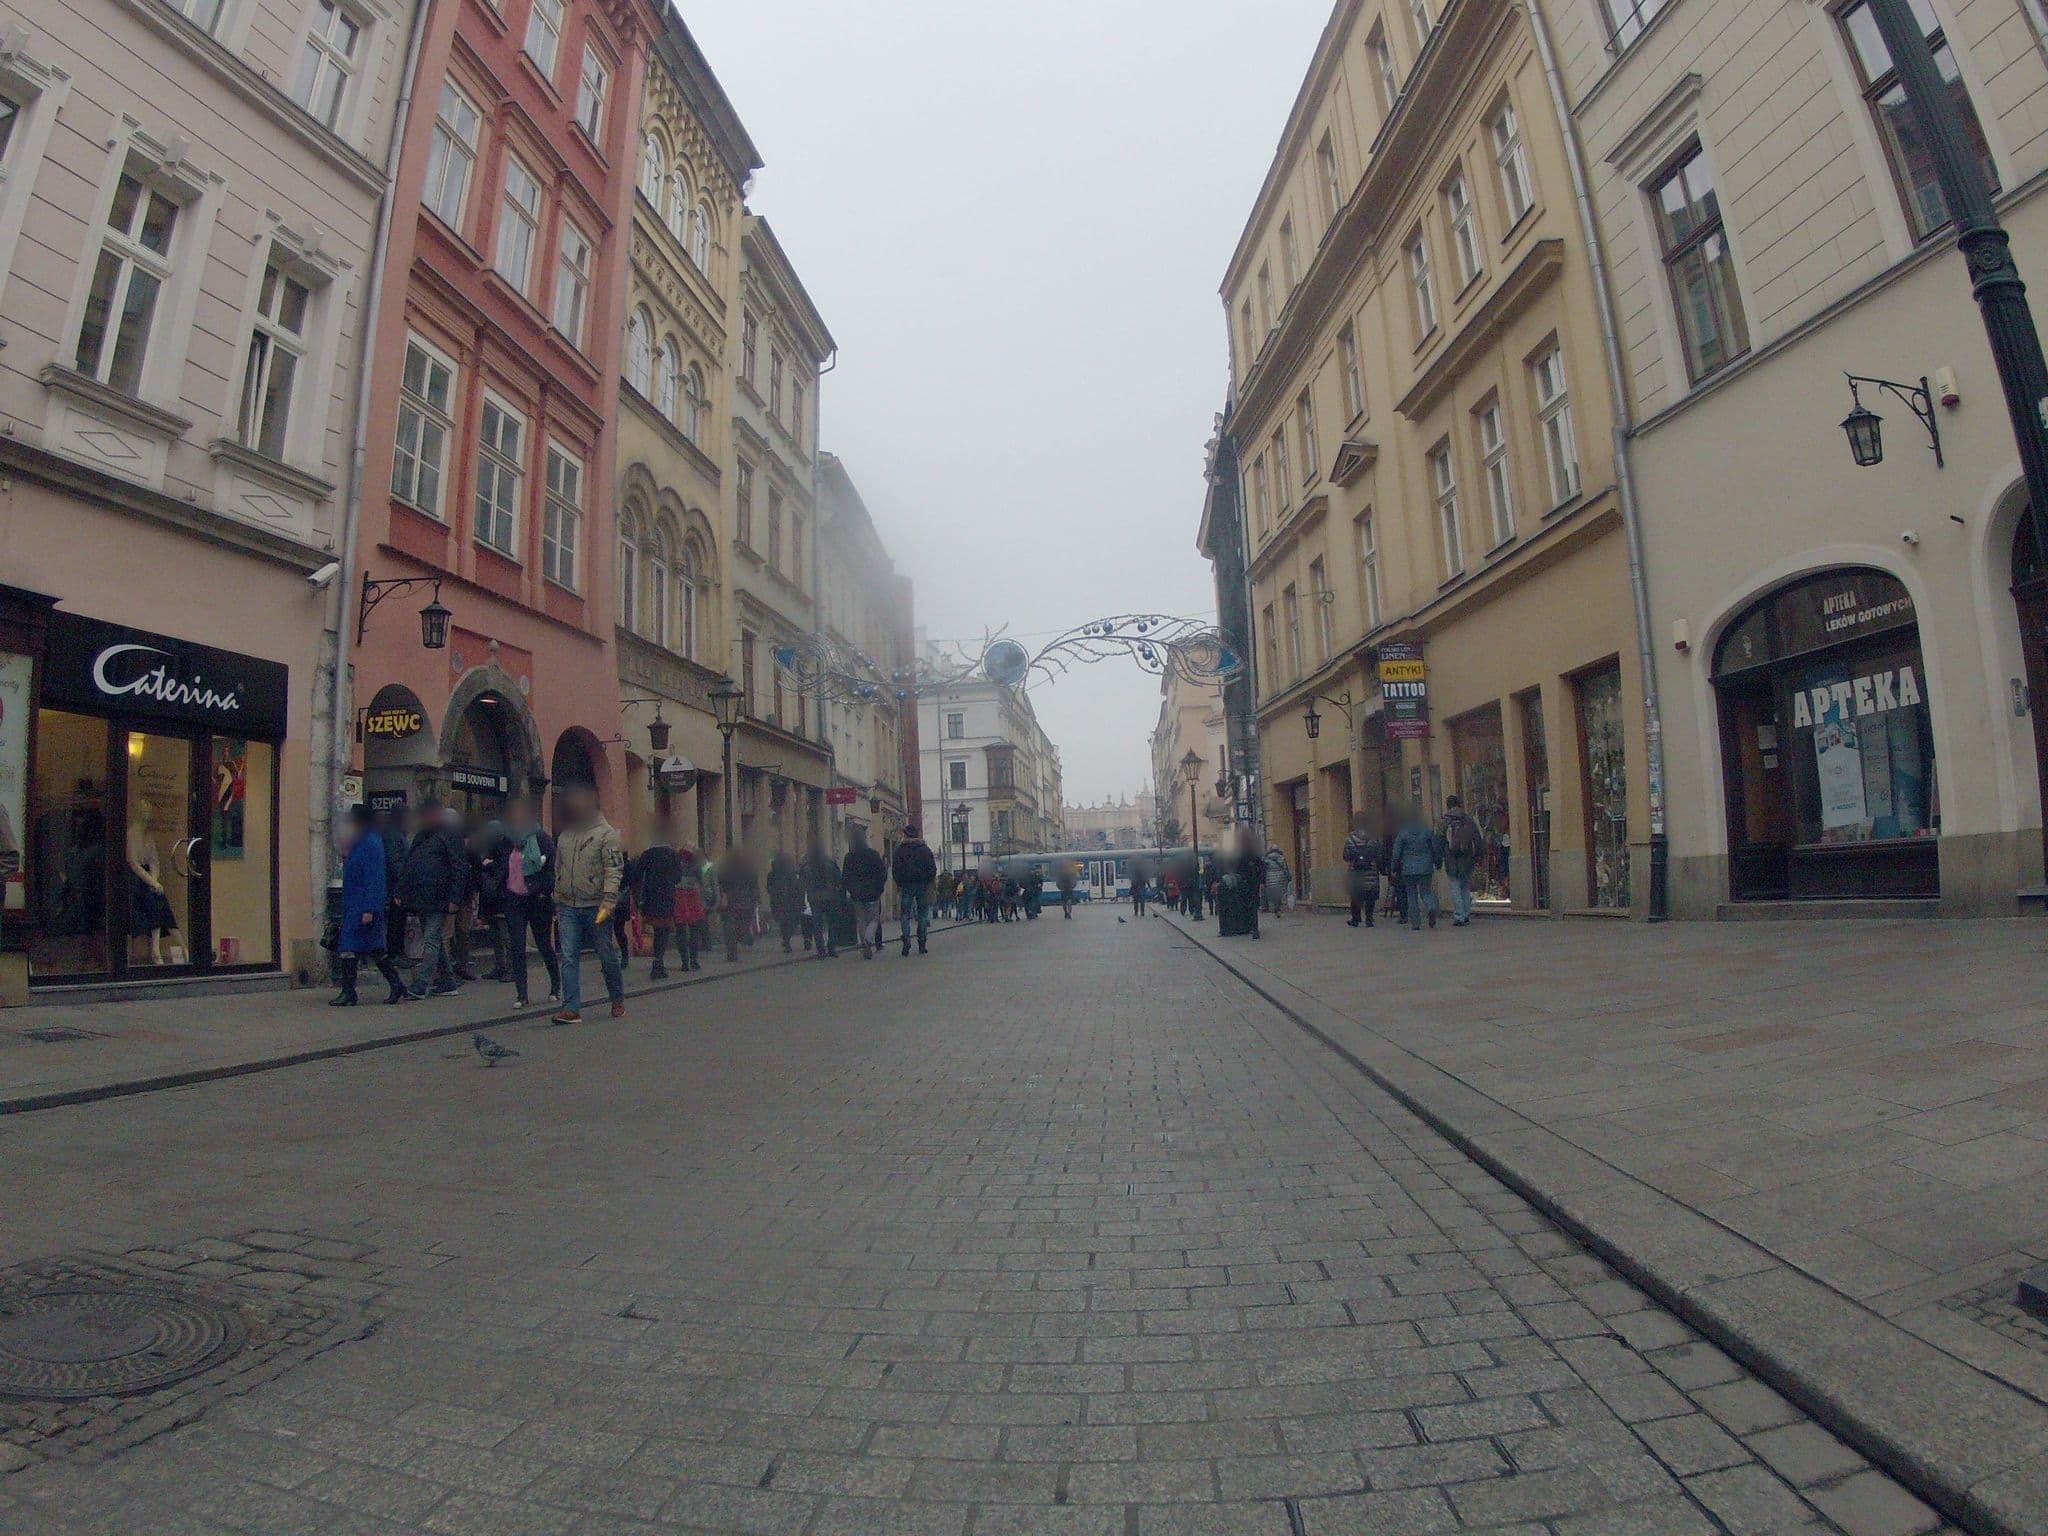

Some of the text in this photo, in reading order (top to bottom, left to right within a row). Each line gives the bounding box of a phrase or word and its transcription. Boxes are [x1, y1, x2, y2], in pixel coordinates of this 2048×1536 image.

[1823, 590, 1857, 615] APTEKA
[1825, 597, 1912, 632] LEKÓW GOTOWYCH
[93, 643, 240, 710] Caterina
[1385, 665, 1421, 676] ANTYKI
[1382, 682, 1426, 698] TATTOO
[1794, 666, 1921, 729] APTEKA
[367, 714, 421, 737] SZEWC
